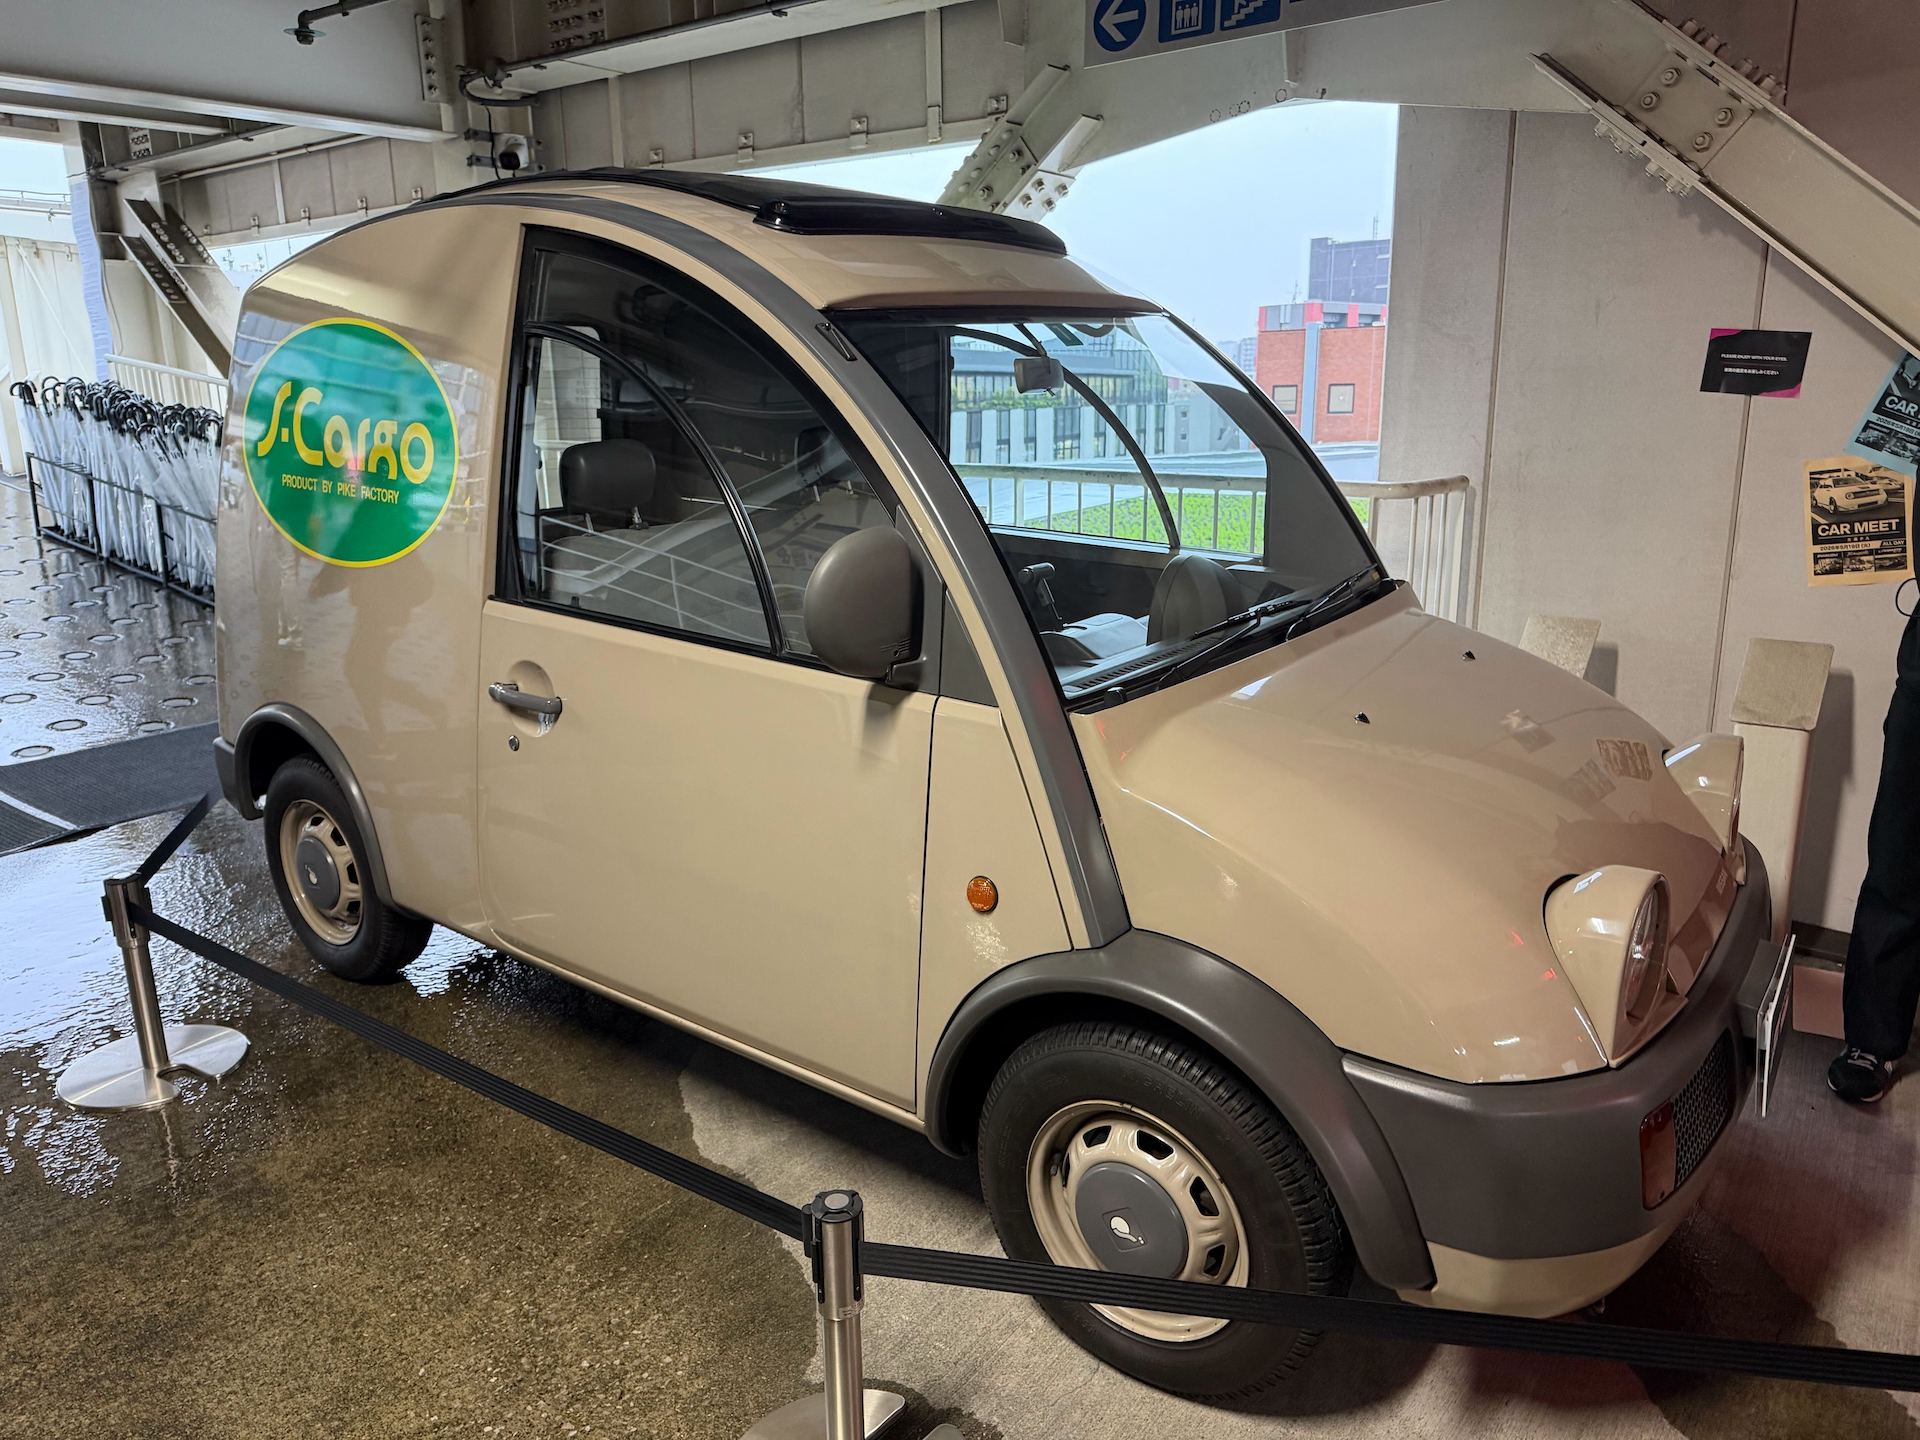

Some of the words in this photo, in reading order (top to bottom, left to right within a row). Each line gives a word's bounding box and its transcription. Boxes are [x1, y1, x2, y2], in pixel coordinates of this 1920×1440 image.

[1885, 396, 1919, 417] CAR
[281, 473, 318, 491] PRODUCT
[322, 478, 333, 494] BY
[337, 482, 356, 498] PIKE
[360, 485, 400, 505] FACTORY
[1817, 523, 1851, 537] CAR
[1853, 519, 1900, 534] MEET
